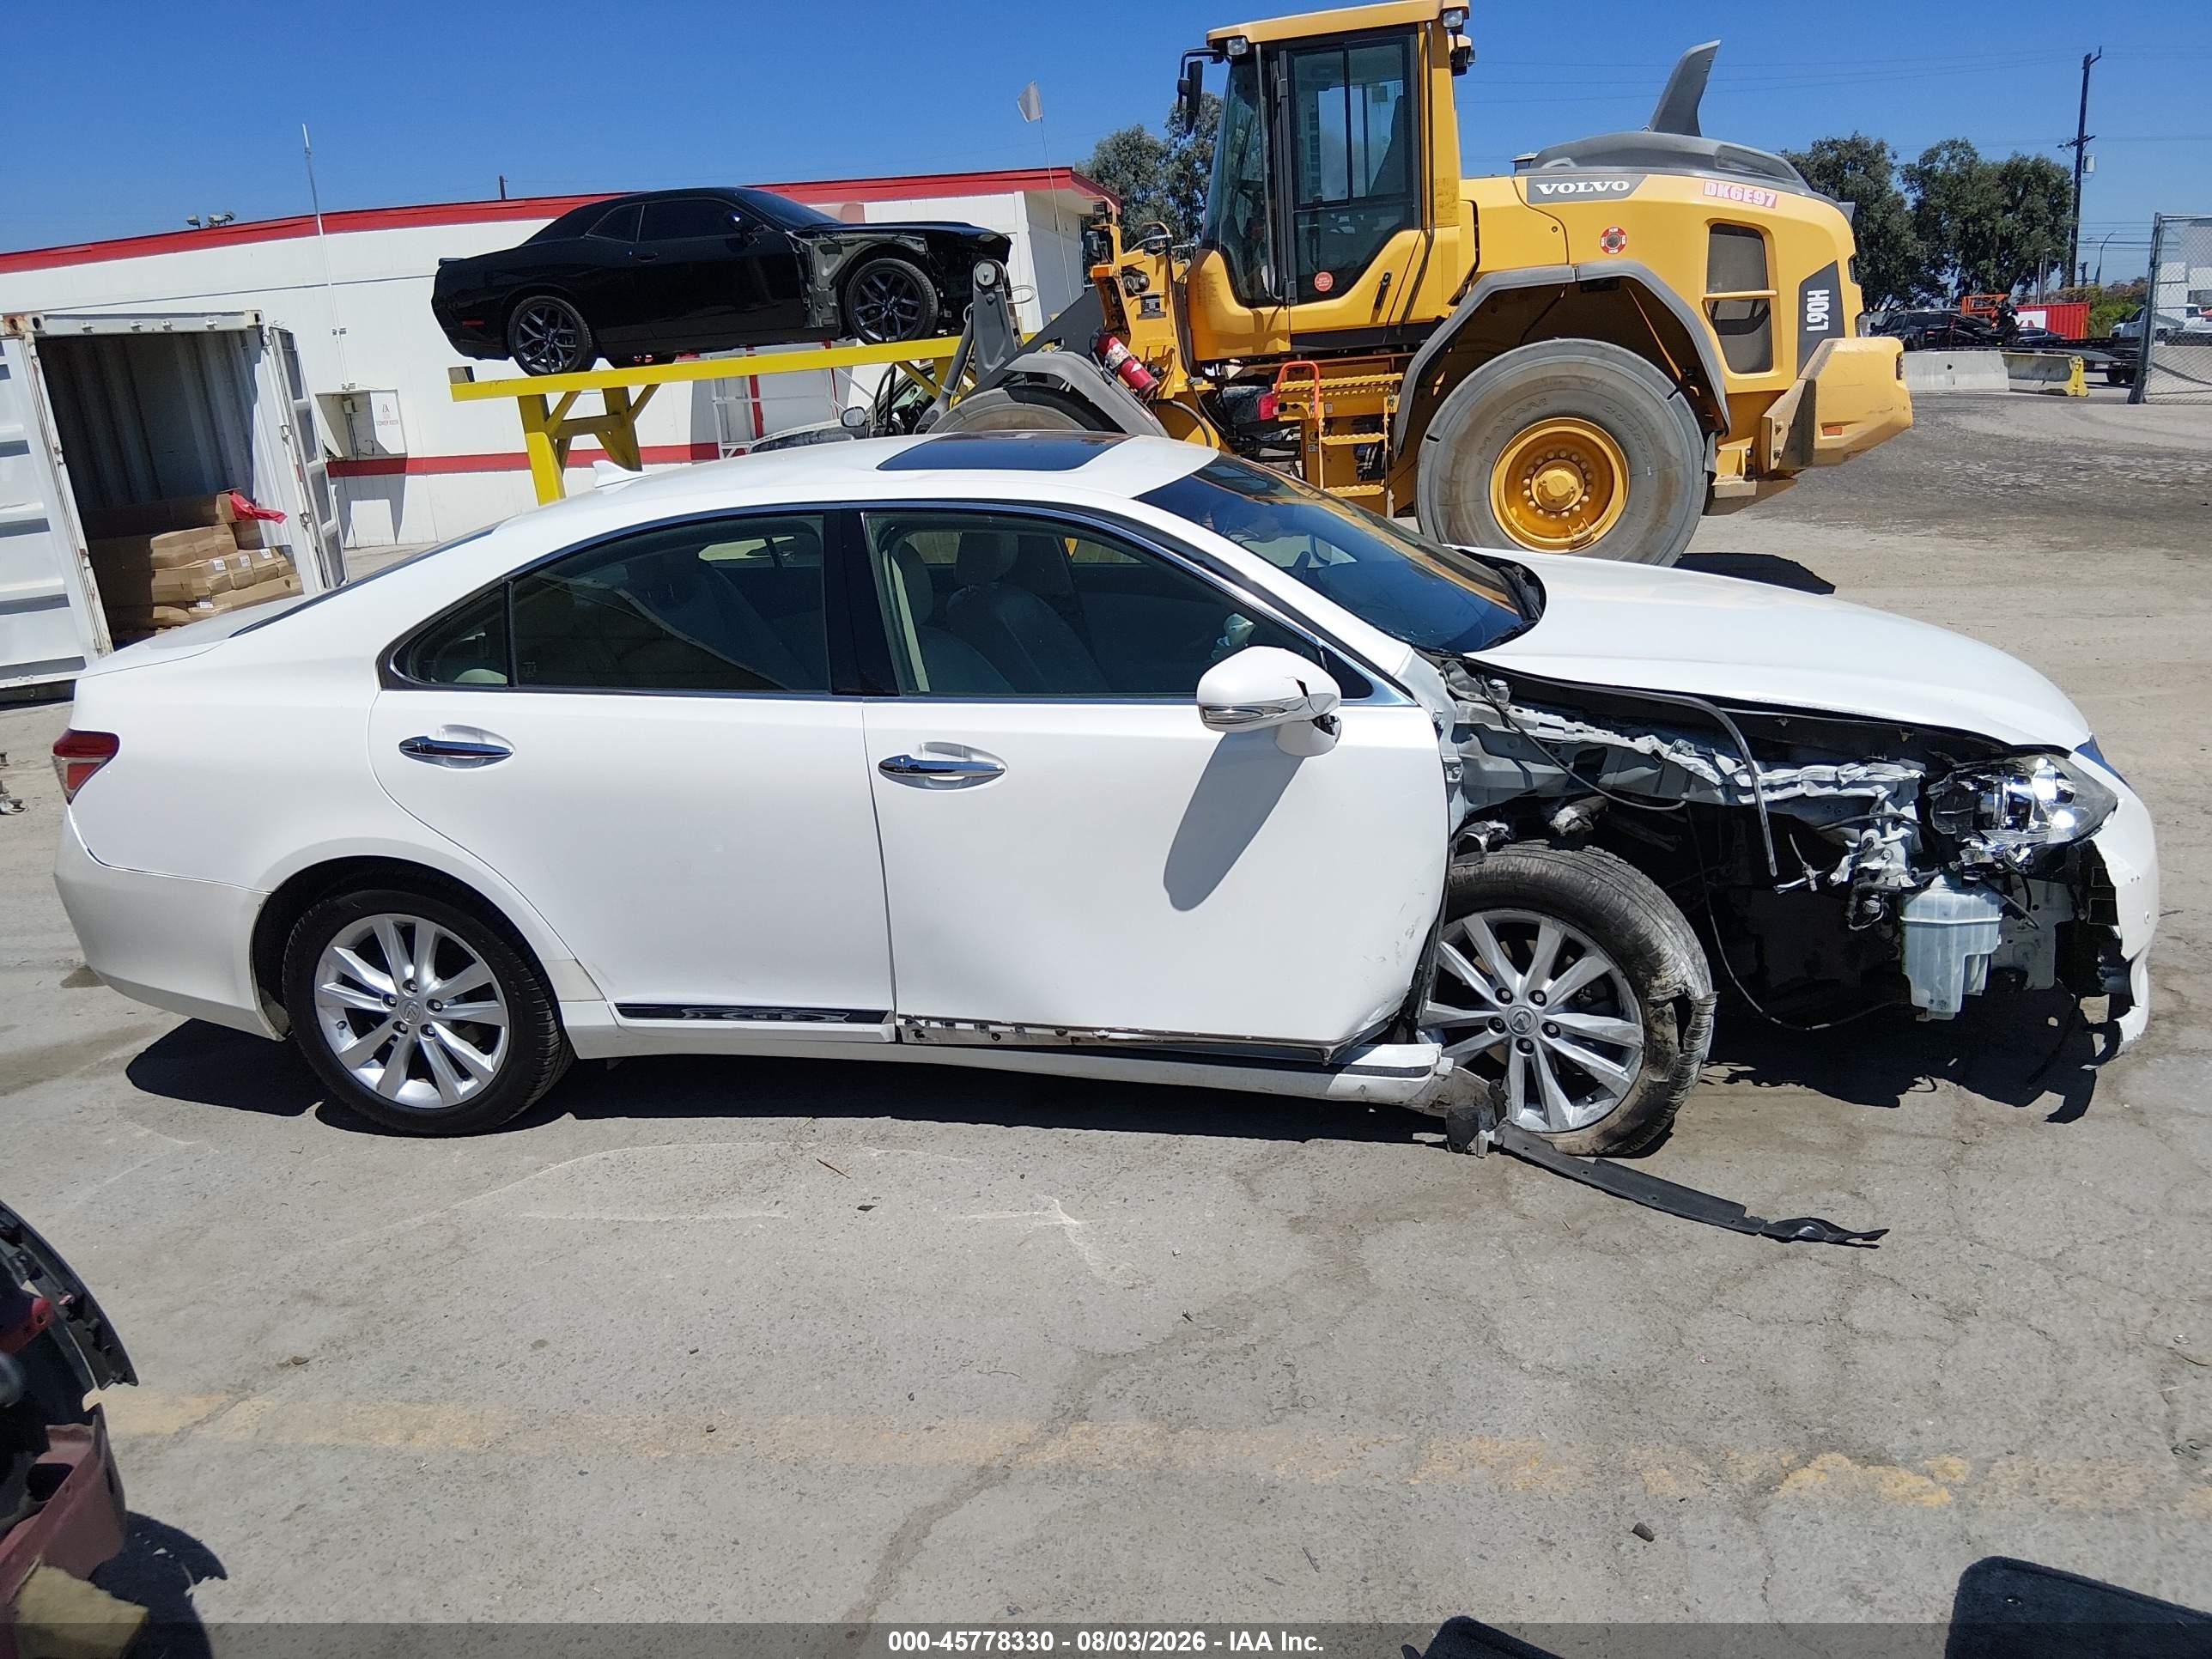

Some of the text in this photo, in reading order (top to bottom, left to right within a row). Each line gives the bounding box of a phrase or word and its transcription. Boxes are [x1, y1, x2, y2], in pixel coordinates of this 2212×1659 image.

[1535, 180, 1630, 195] VOLVO
[1704, 180, 1777, 208] DK6E97
[1806, 289, 1830, 331] L90H
